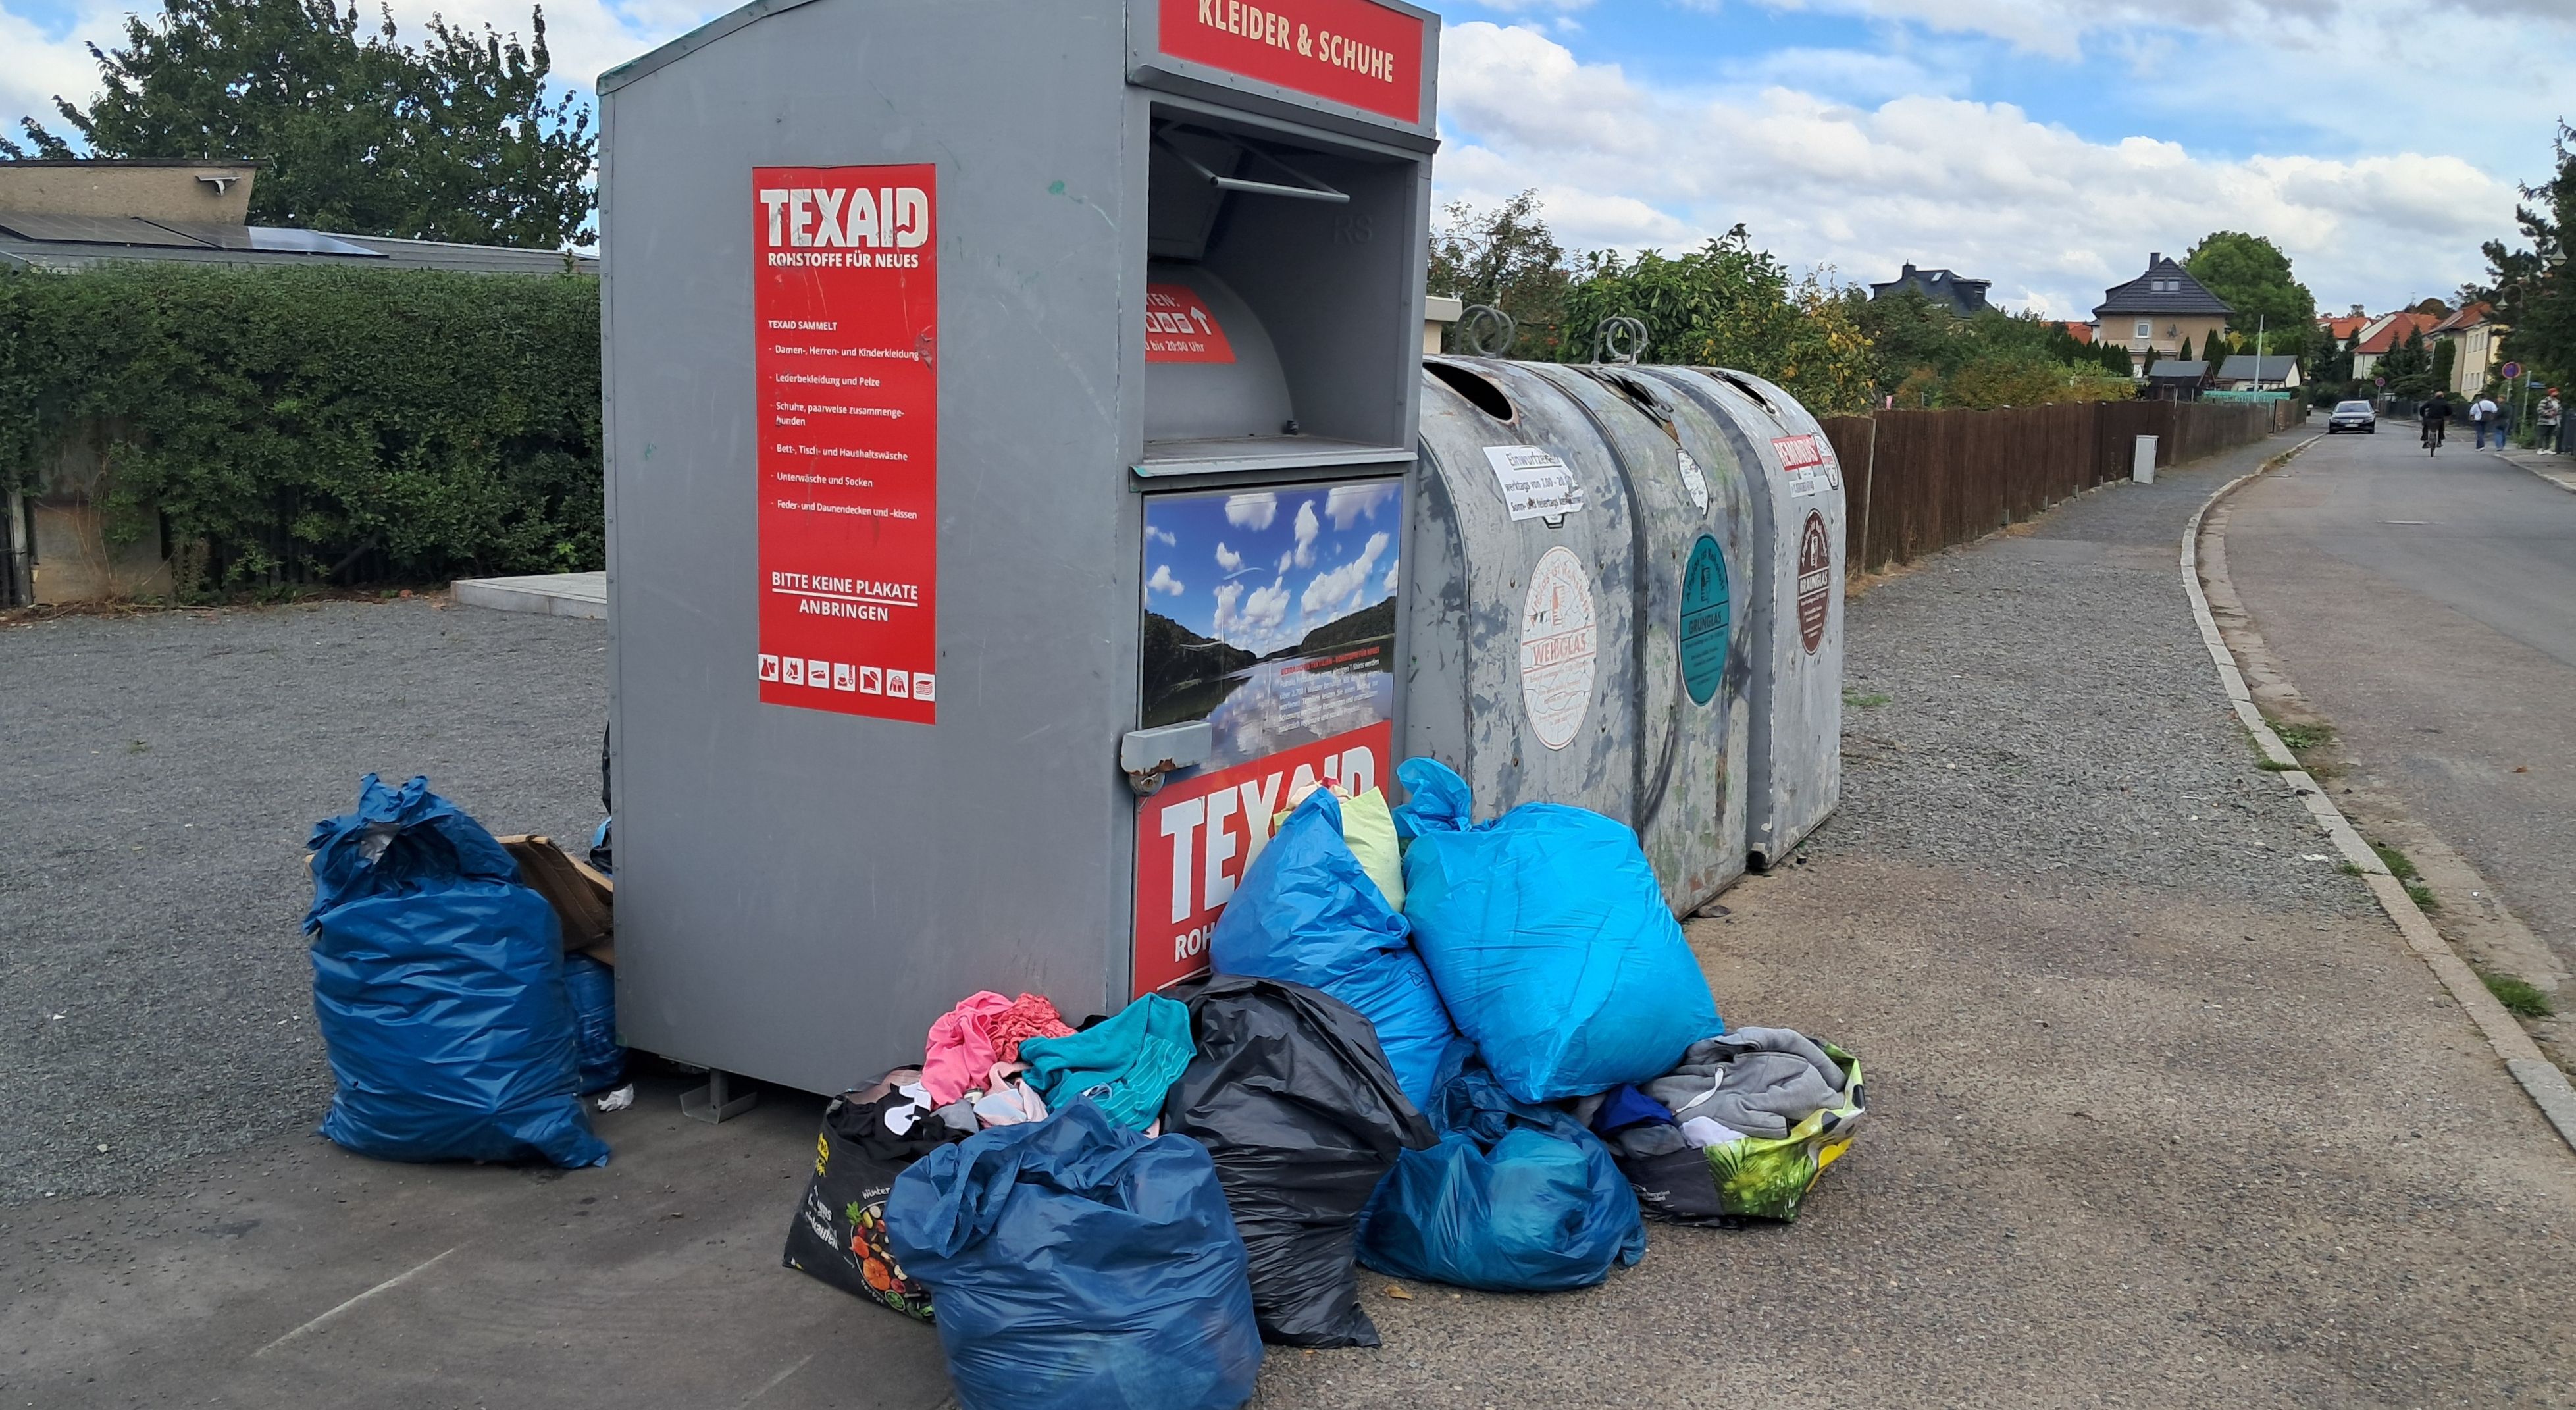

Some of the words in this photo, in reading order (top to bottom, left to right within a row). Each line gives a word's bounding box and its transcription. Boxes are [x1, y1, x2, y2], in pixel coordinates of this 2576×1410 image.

[1198, 0, 1291, 51] KLEIDER
[1297, 24, 1312, 57] &
[1318, 30, 1395, 83] SCHUHE
[760, 187, 929, 248] TEXAID
[768, 252, 842, 268] ROHSTOFFE
[846, 250, 872, 269] FÜR
[875, 253, 919, 269] NEUES
[768, 320, 797, 330] TEXAID
[798, 320, 838, 332] SAMMELT
[775, 344, 808, 356] Damen-,
[809, 346, 840, 357] Herren-
[841, 347, 857, 357] und
[858, 348, 919, 362] Kinderkleidung
[1150, 340, 1165, 352] bis
[1165, 340, 1189, 352] 20:00
[1189, 341, 1205, 352] Uhr
[775, 373, 840, 388] Lederbekleidung
[841, 376, 857, 387] und
[858, 377, 881, 388] Pelze
[775, 401, 807, 415] Schuhe,
[807, 404, 848, 417] paarweise
[848, 405, 905, 419] zusammenge-
[776, 443, 797, 455] Bett-,
[798, 444, 821, 456] Tisch-
[822, 447, 838, 458] und
[839, 448, 909, 462] Haushaltswäsche
[777, 471, 827, 485] Unterwäsche
[827, 475, 844, 486] und
[845, 476, 873, 488] Socken
[777, 499, 800, 511] Feder-
[801, 502, 816, 512] und
[816, 502, 873, 517] Daunendecken
[873, 506, 889, 518] und
[771, 571, 809, 590] BITTE
[811, 574, 853, 594] KEINE
[856, 581, 919, 600] PLAKATE
[1799, 570, 1828, 594] BRAUNGLAS
[798, 598, 890, 623] ANBRINGEN
[1160, 746, 1376, 924] TEX
[862, 1186, 890, 1199] Winter
